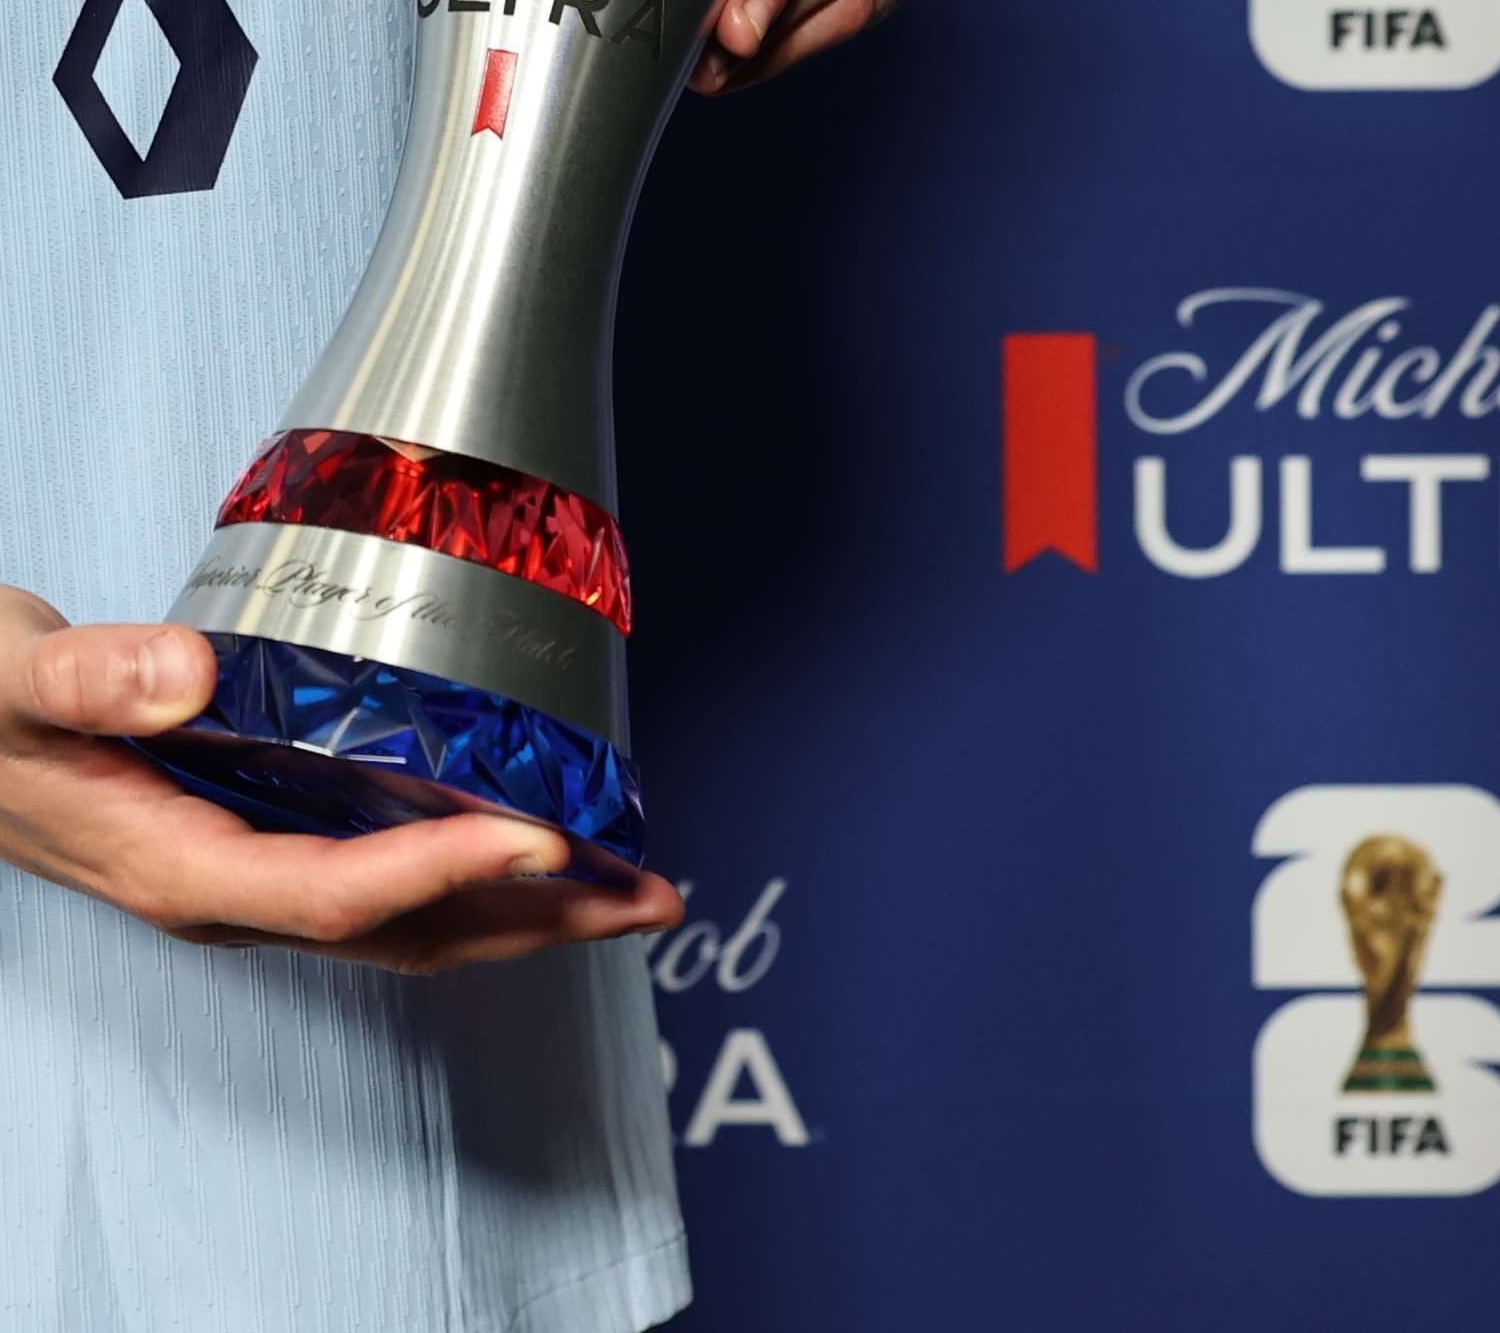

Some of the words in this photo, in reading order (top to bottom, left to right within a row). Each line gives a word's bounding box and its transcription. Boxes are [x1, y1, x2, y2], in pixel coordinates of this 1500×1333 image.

[1331, 11, 1444, 48] FIFA
[260, 558, 372, 609] Player
[1336, 1118, 1448, 1153] FIFA
